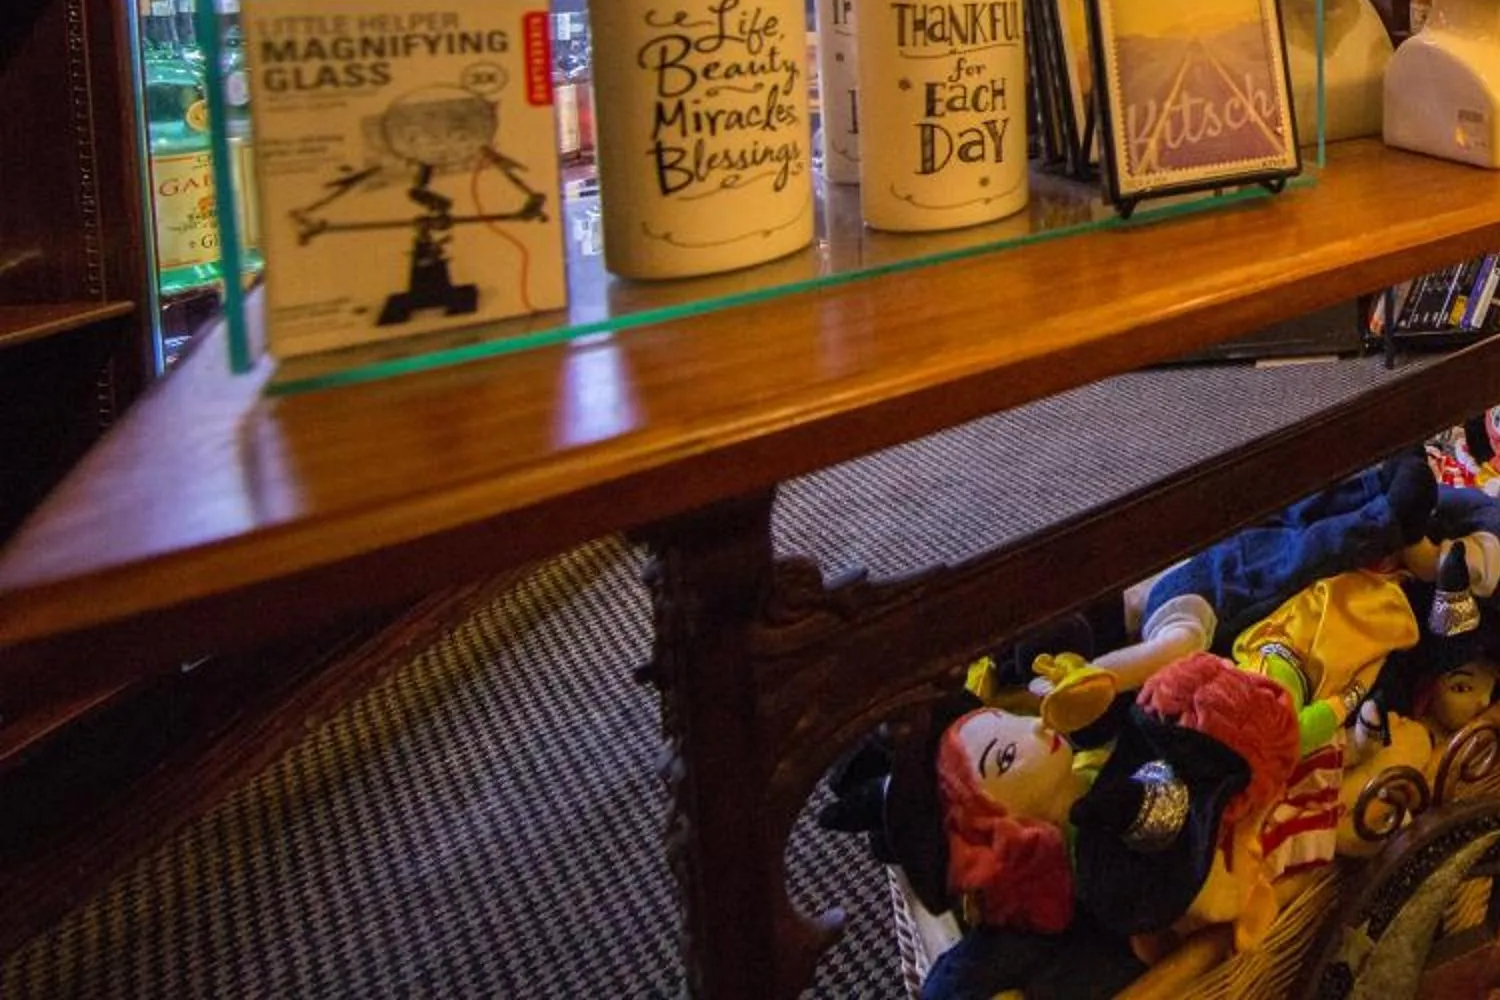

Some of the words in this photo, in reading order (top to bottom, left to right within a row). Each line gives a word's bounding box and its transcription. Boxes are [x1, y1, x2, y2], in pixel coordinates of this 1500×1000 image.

[260, 31, 509, 64] MAGNIFYING
[262, 61, 393, 94] GLASS
[947, 57, 987, 83] for
